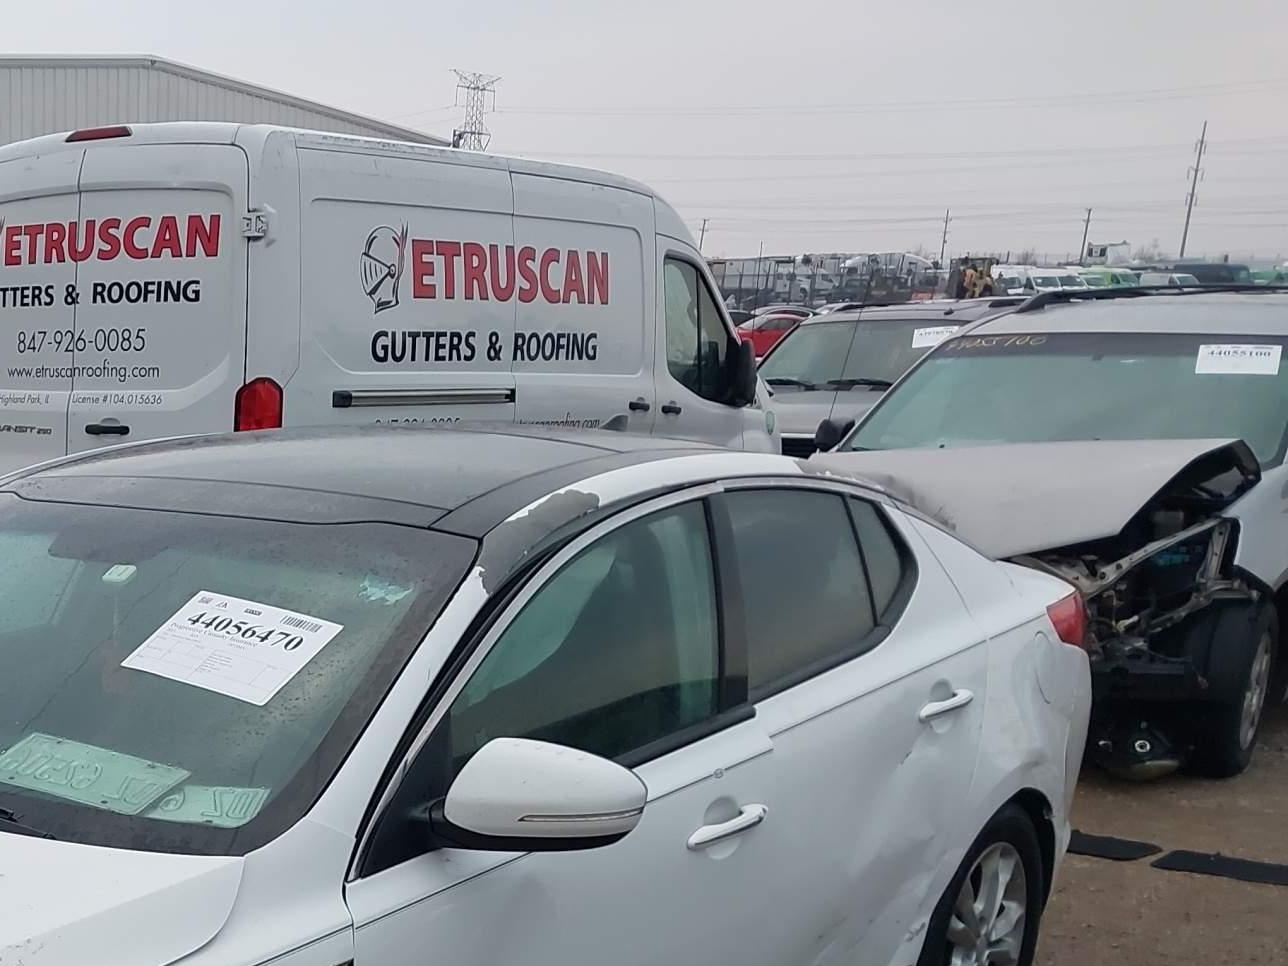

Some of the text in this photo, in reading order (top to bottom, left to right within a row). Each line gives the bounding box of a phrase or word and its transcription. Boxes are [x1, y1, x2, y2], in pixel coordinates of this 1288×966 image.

[4, 214, 221, 266] ETRUSCAN
[411, 239, 609, 305] ETRUSCAN
[64, 284, 80, 305] &
[92, 280, 200, 303] ROOFING
[17, 328, 146, 354] 847-926-0085
[371, 330, 598, 362] GUTTERS & ROOFING
[7, 358, 160, 382] www.etruscanroofing.com
[72, 394, 100, 405] License
[187, 611, 304, 652] 44056470
